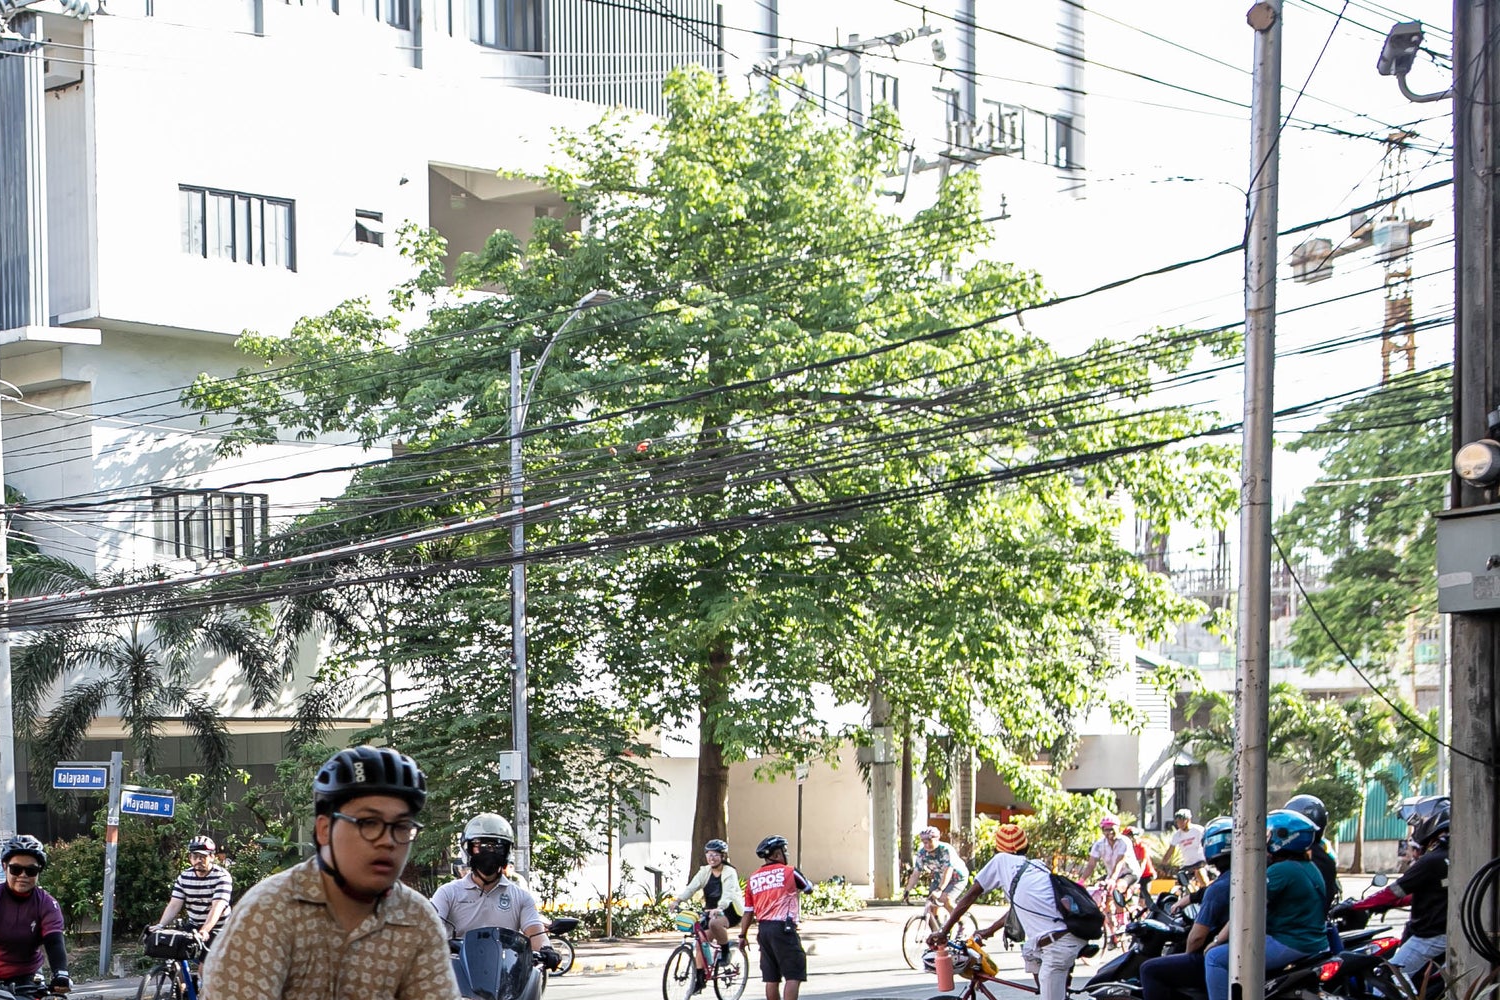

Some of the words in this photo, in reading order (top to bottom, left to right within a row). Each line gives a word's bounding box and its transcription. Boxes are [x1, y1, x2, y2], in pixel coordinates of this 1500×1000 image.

[57, 772, 90, 786] Kalayaan
[126, 797, 159, 812] Mayaman
[750, 872, 785, 890] DPOS
